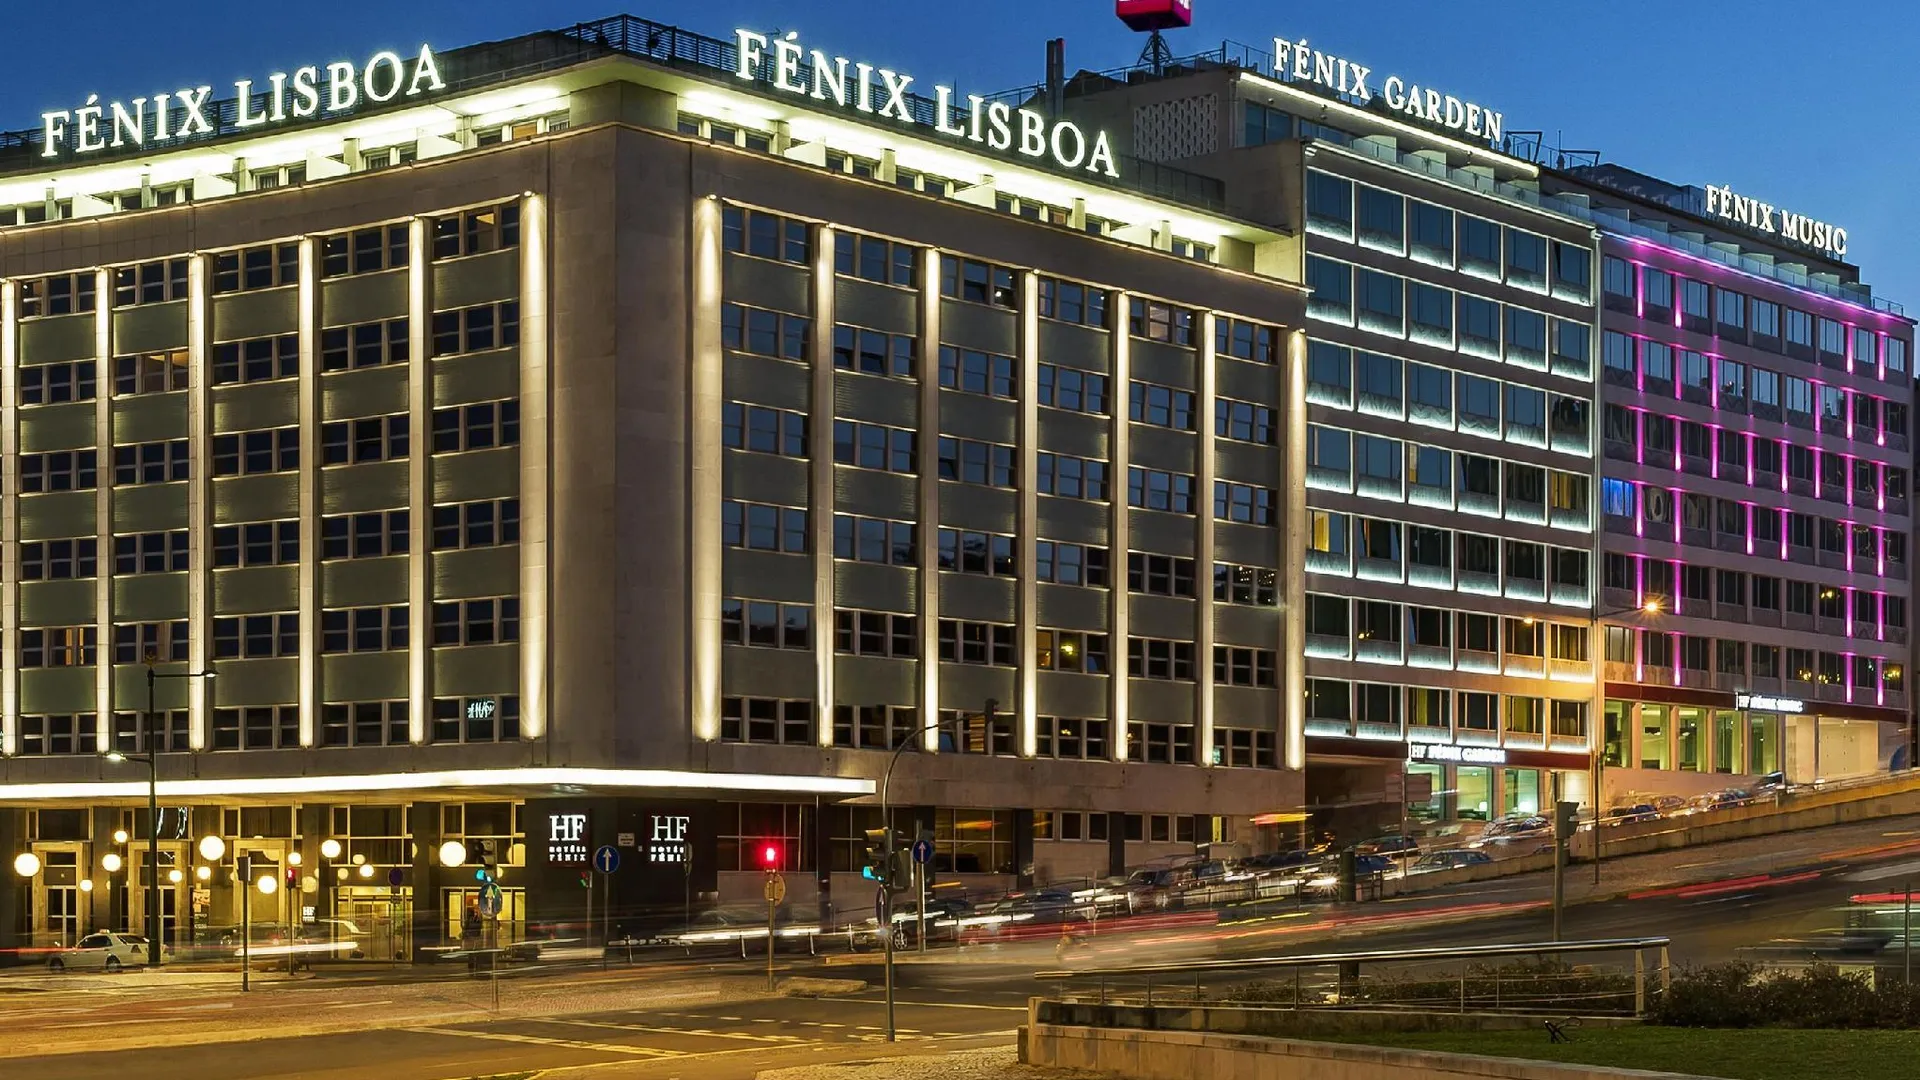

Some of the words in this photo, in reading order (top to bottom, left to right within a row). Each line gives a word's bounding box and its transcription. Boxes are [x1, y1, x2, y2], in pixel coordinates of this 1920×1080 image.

[41, 84, 214, 157] FÉNIX
[234, 42, 447, 128] LISBOA
[735, 27, 915, 124] FÉNIX
[934, 84, 1120, 179] LISBOA
[1273, 37, 1371, 101] FÉNIX
[1383, 76, 1503, 143] GARDEN
[1705, 184, 1775, 233] FÉNIX
[1780, 209, 1847, 255] MUSIC
[549, 814, 586, 841] HF
[651, 815, 690, 841] HF
